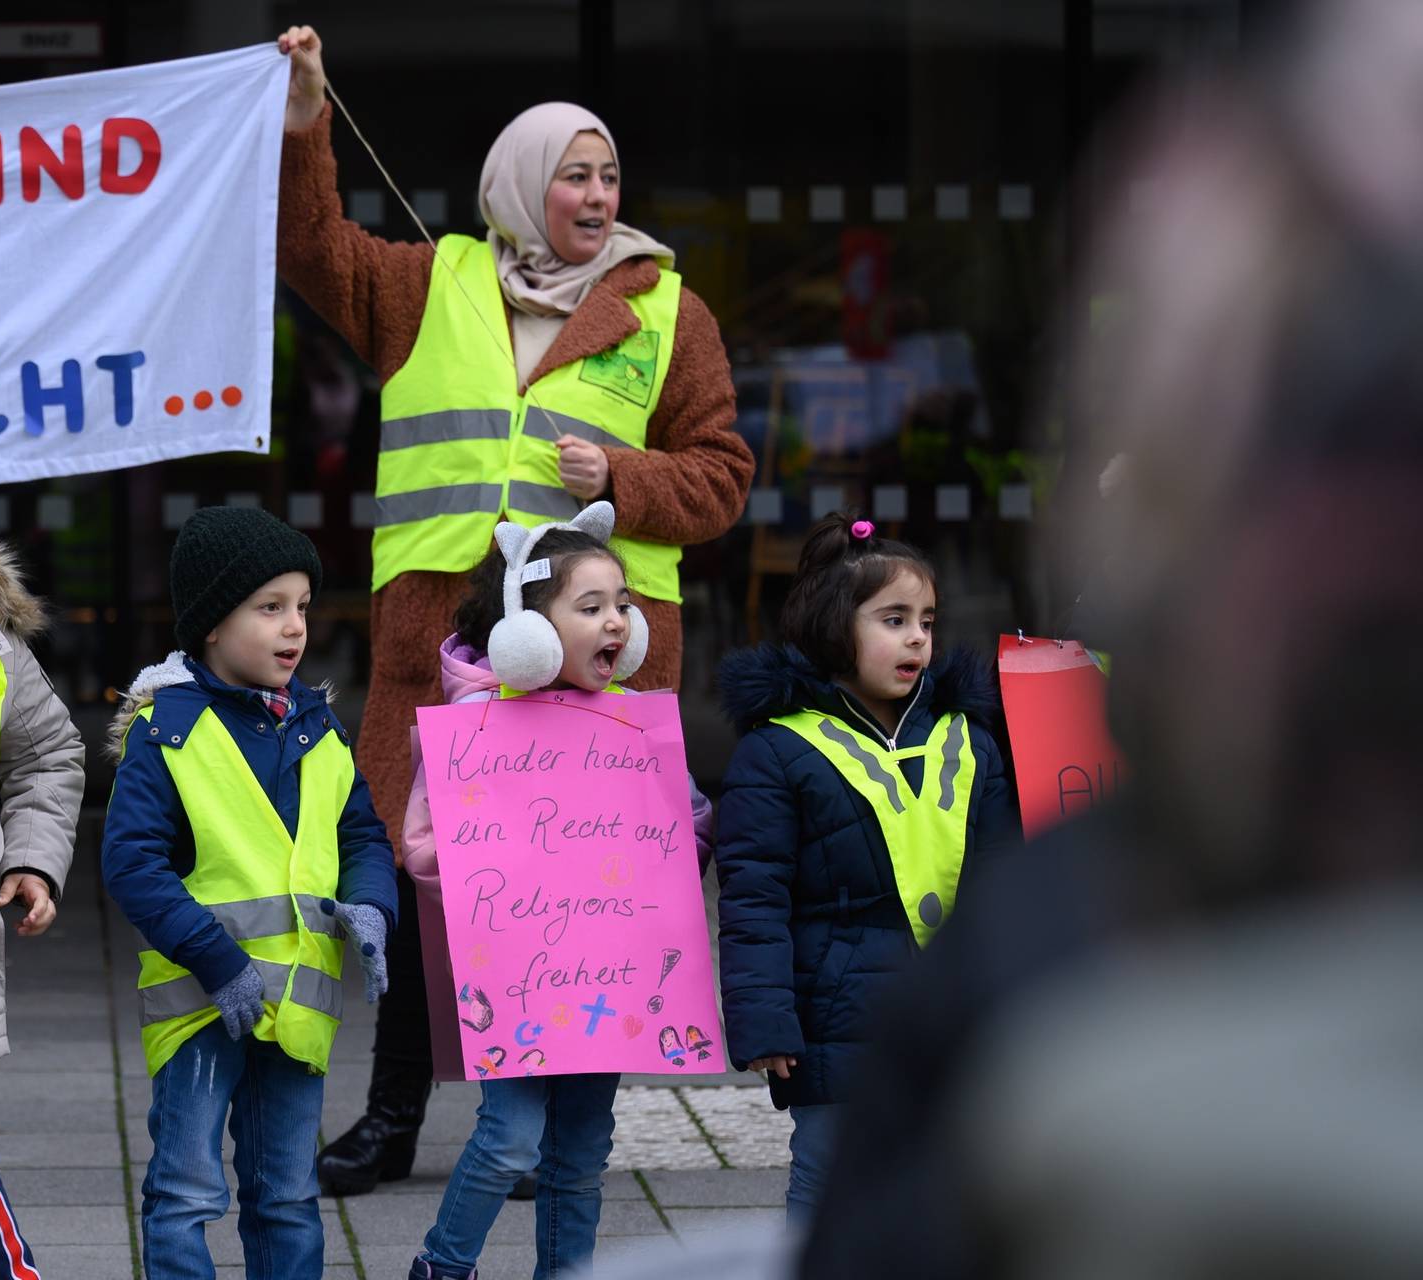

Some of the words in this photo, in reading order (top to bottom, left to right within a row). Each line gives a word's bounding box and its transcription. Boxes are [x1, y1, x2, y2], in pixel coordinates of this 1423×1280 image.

[447, 730, 565, 782] Kinder
[583, 732, 664, 774] haben
[450, 818, 507, 846] ein
[527, 797, 624, 854] Recht
[634, 819, 679, 860] auf
[464, 868, 659, 946] Religions-
